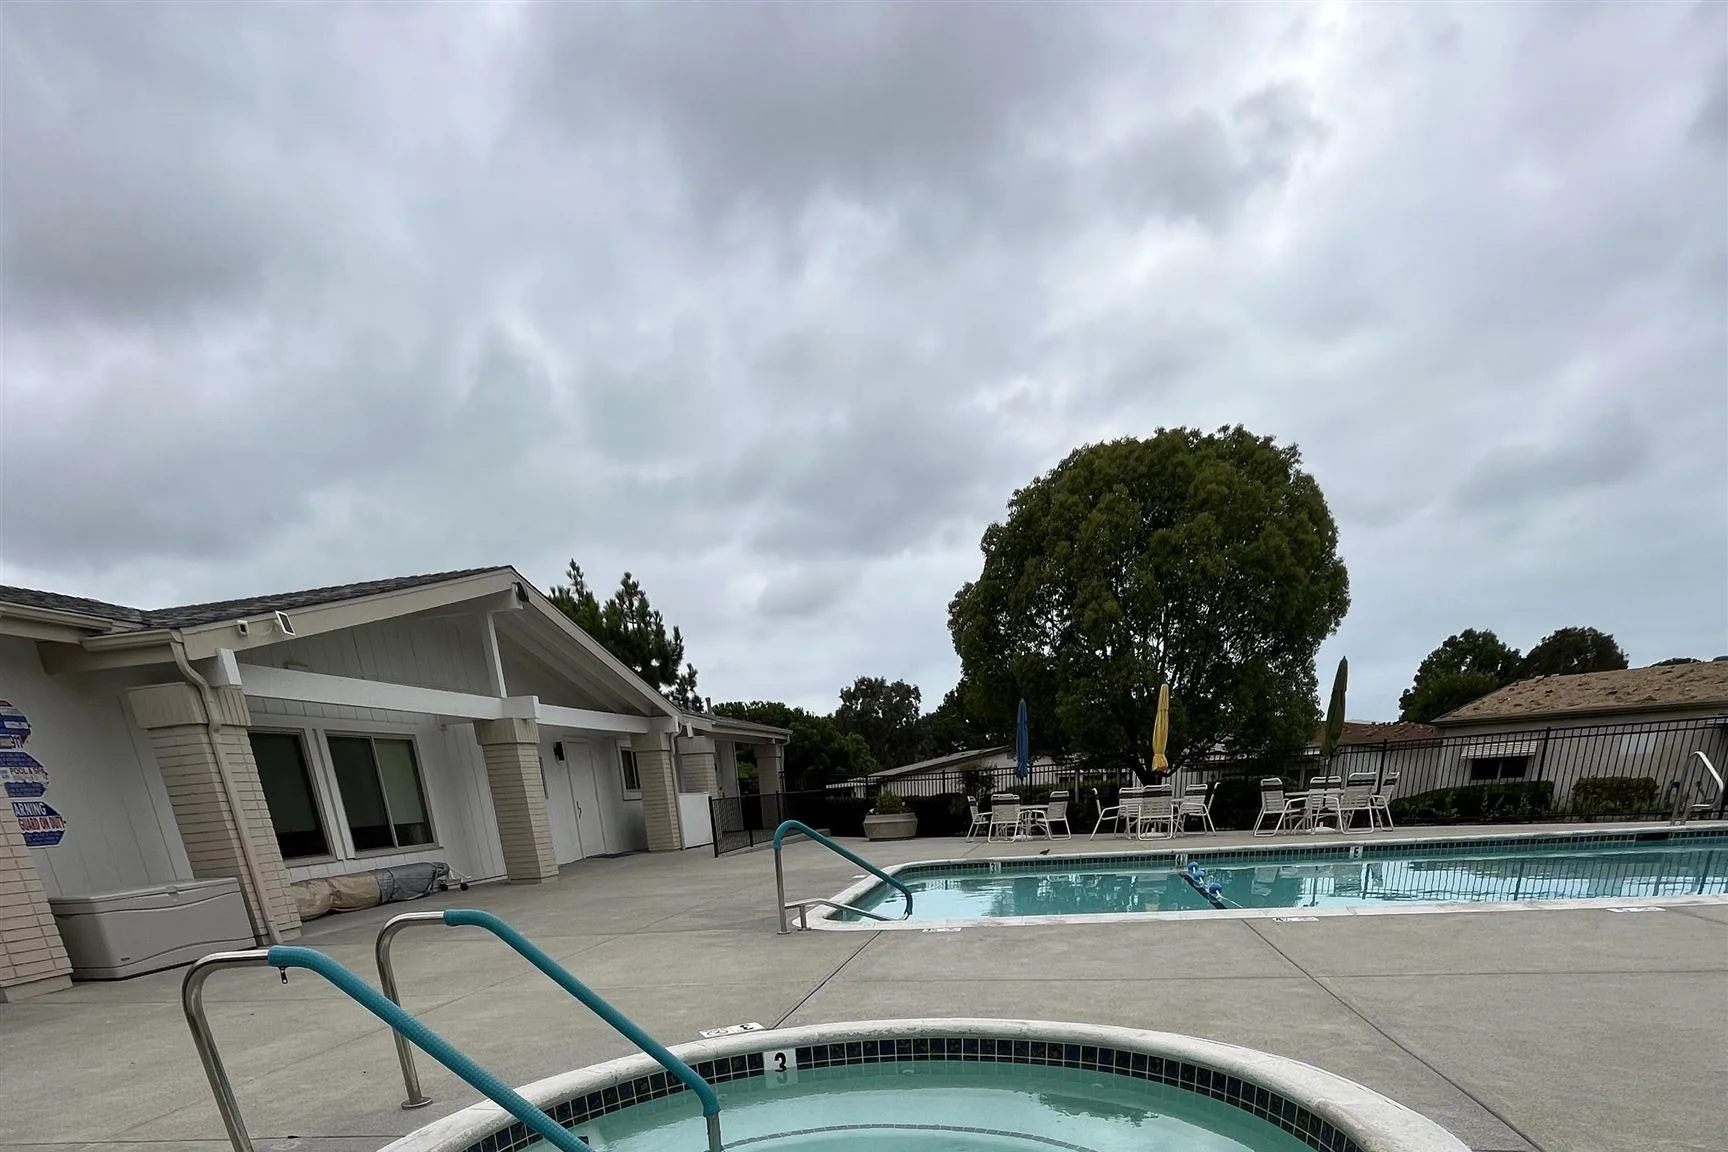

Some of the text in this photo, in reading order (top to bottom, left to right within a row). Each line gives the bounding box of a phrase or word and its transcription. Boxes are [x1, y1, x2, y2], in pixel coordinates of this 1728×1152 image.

[14, 802, 47, 816] ARNING
[18, 817, 40, 831] GUARD
[774, 1052, 787, 1072] 3
